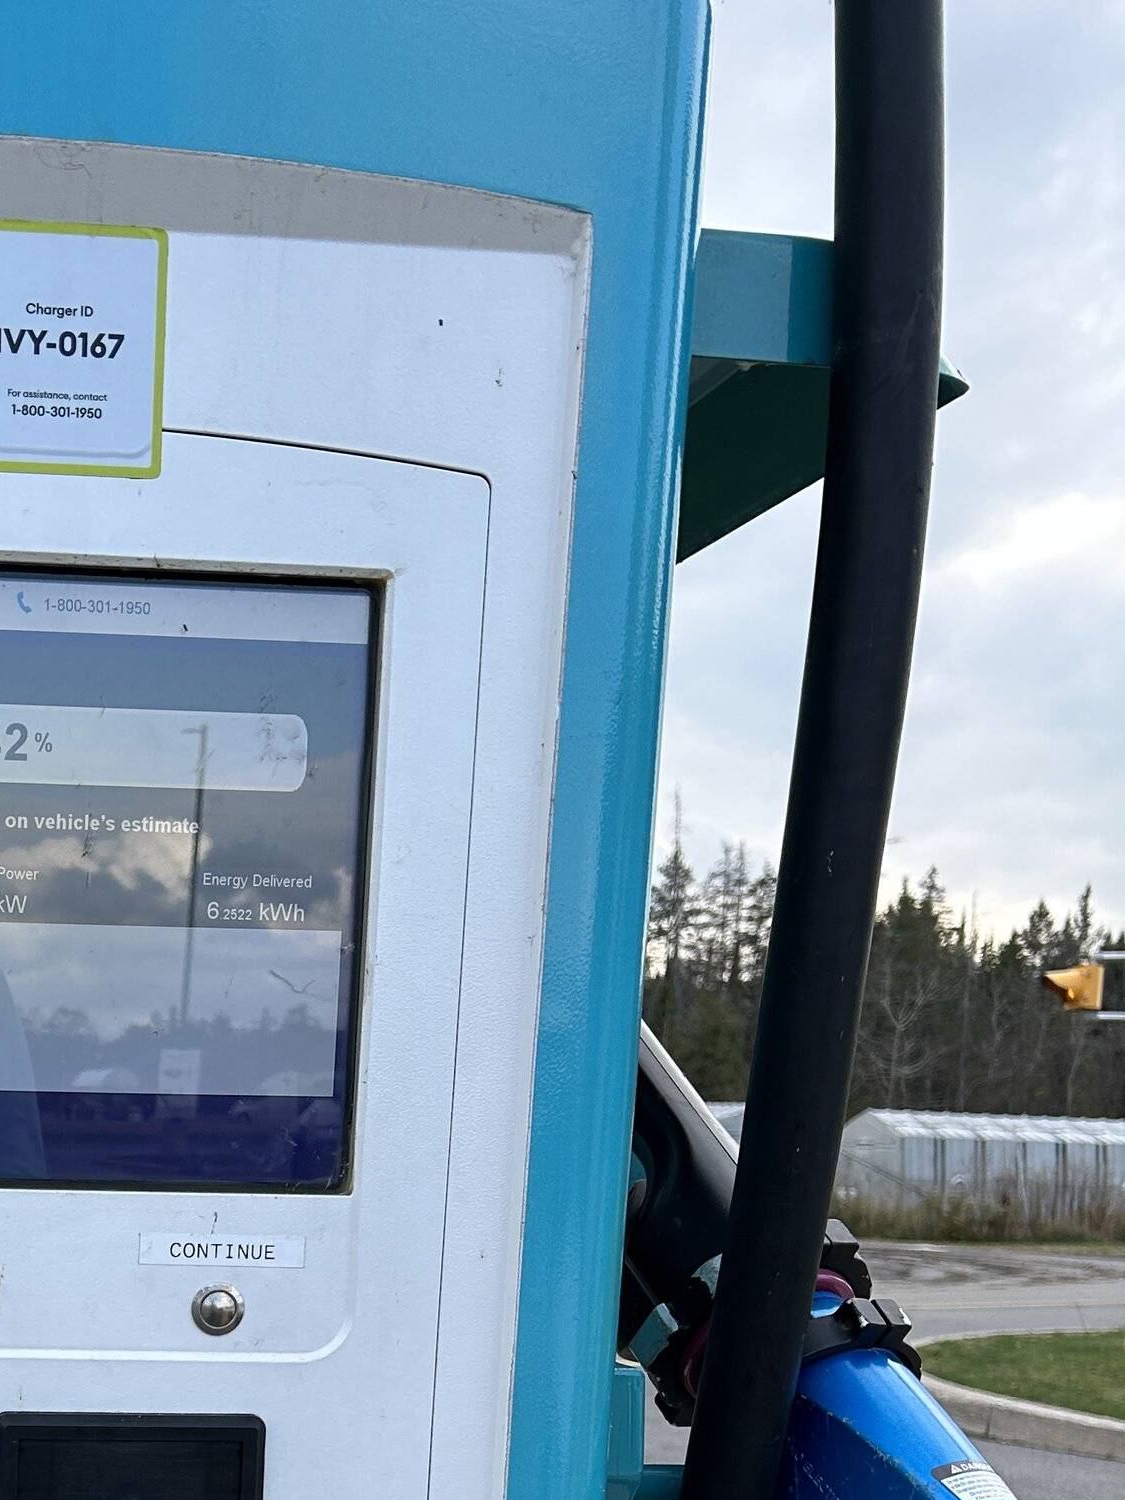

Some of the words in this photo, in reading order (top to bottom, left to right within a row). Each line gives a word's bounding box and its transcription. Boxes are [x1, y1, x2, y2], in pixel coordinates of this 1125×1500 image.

[25, 302, 78, 319] Charger
[80, 304, 94, 317] ID
[7, 388, 21, 398] For
[22, 389, 71, 402] assistance,
[73, 391, 108, 402] contact
[11, 404, 103, 420] 1-800-301-1950
[44, 598, 152, 616] 1-800-301-1950
[4, 814, 29, 830] on
[34, 812, 115, 832] vehicle's
[120, 816, 200, 834] estimate
[203, 872, 248, 889] Energy
[252, 873, 313, 889] Delivered
[259, 902, 305, 922] kWh
[169, 1240, 276, 1262] CONTINUE
